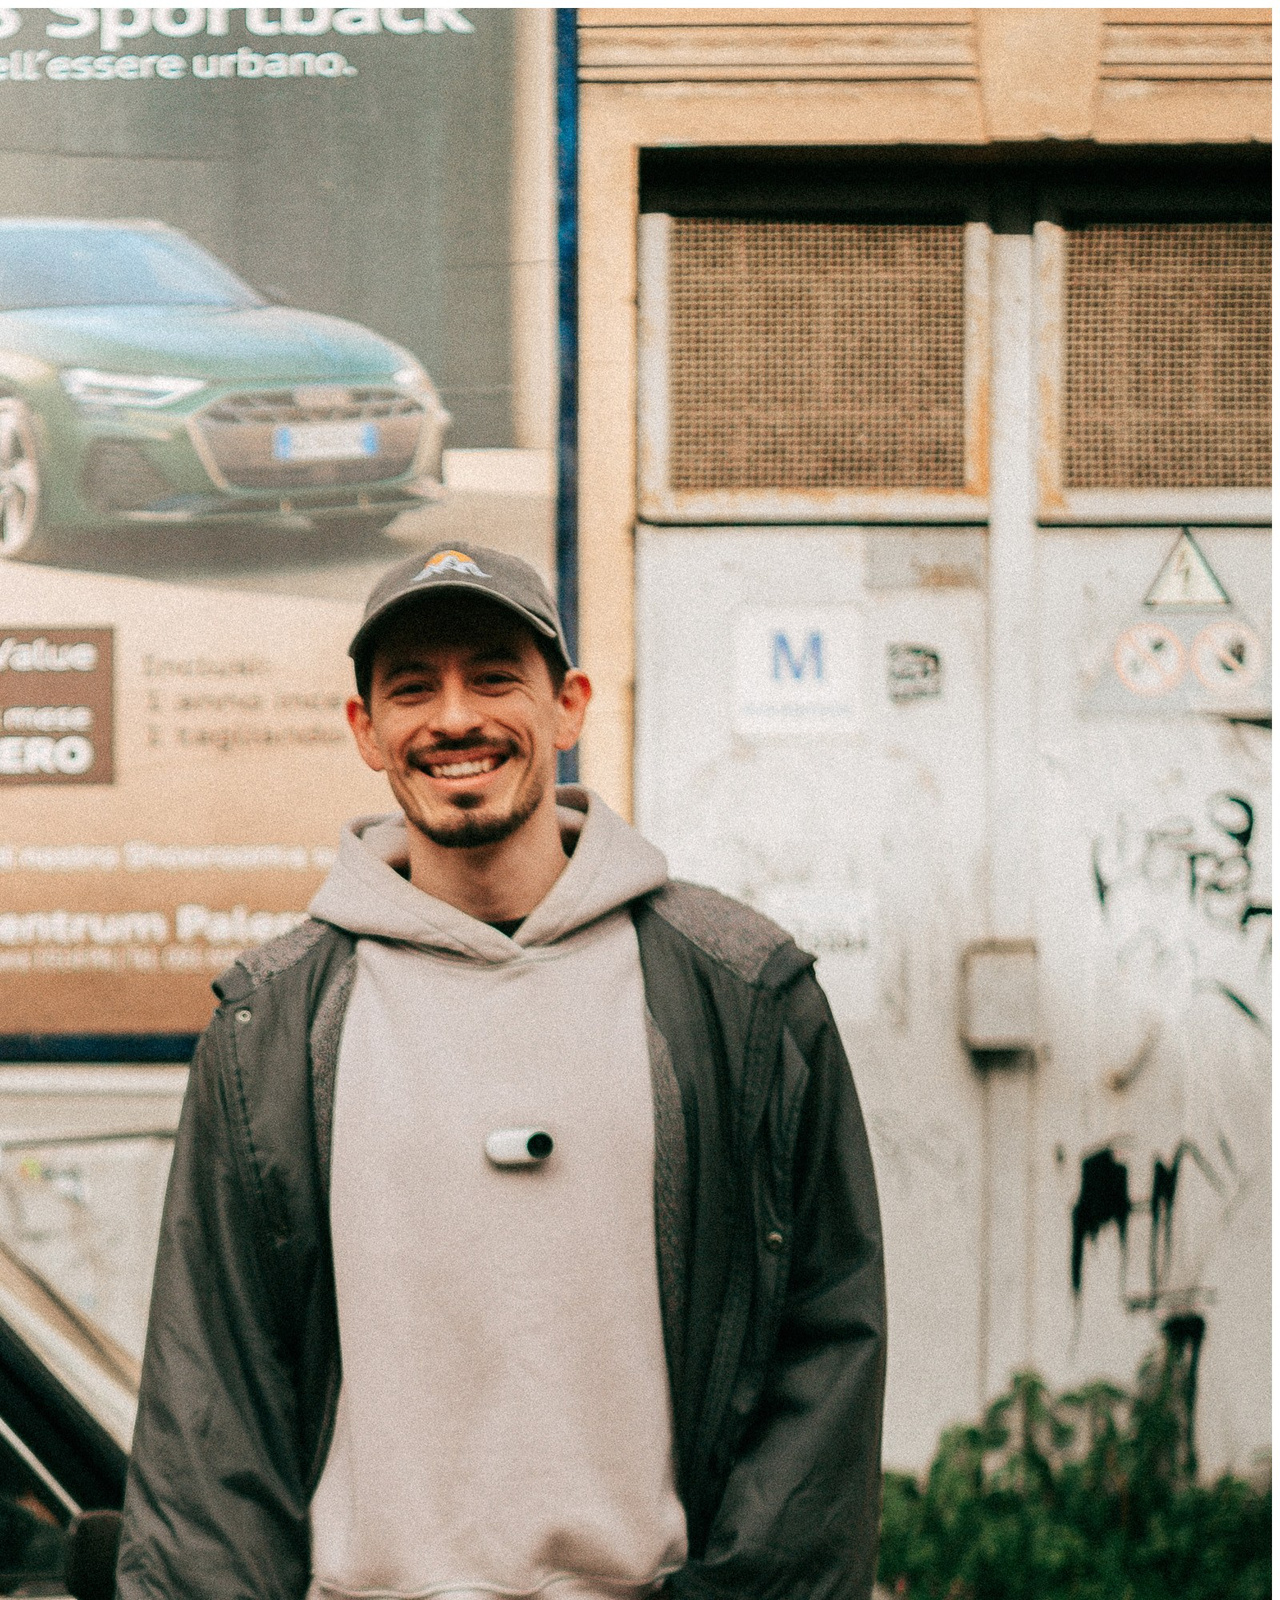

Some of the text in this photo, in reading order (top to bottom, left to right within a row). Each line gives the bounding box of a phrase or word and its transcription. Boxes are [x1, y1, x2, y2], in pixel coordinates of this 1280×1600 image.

[46, 8, 475, 52] Sportback
[192, 46, 359, 80] urbano.
[773, 629, 823, 678] M
[4, 704, 95, 733] mese
